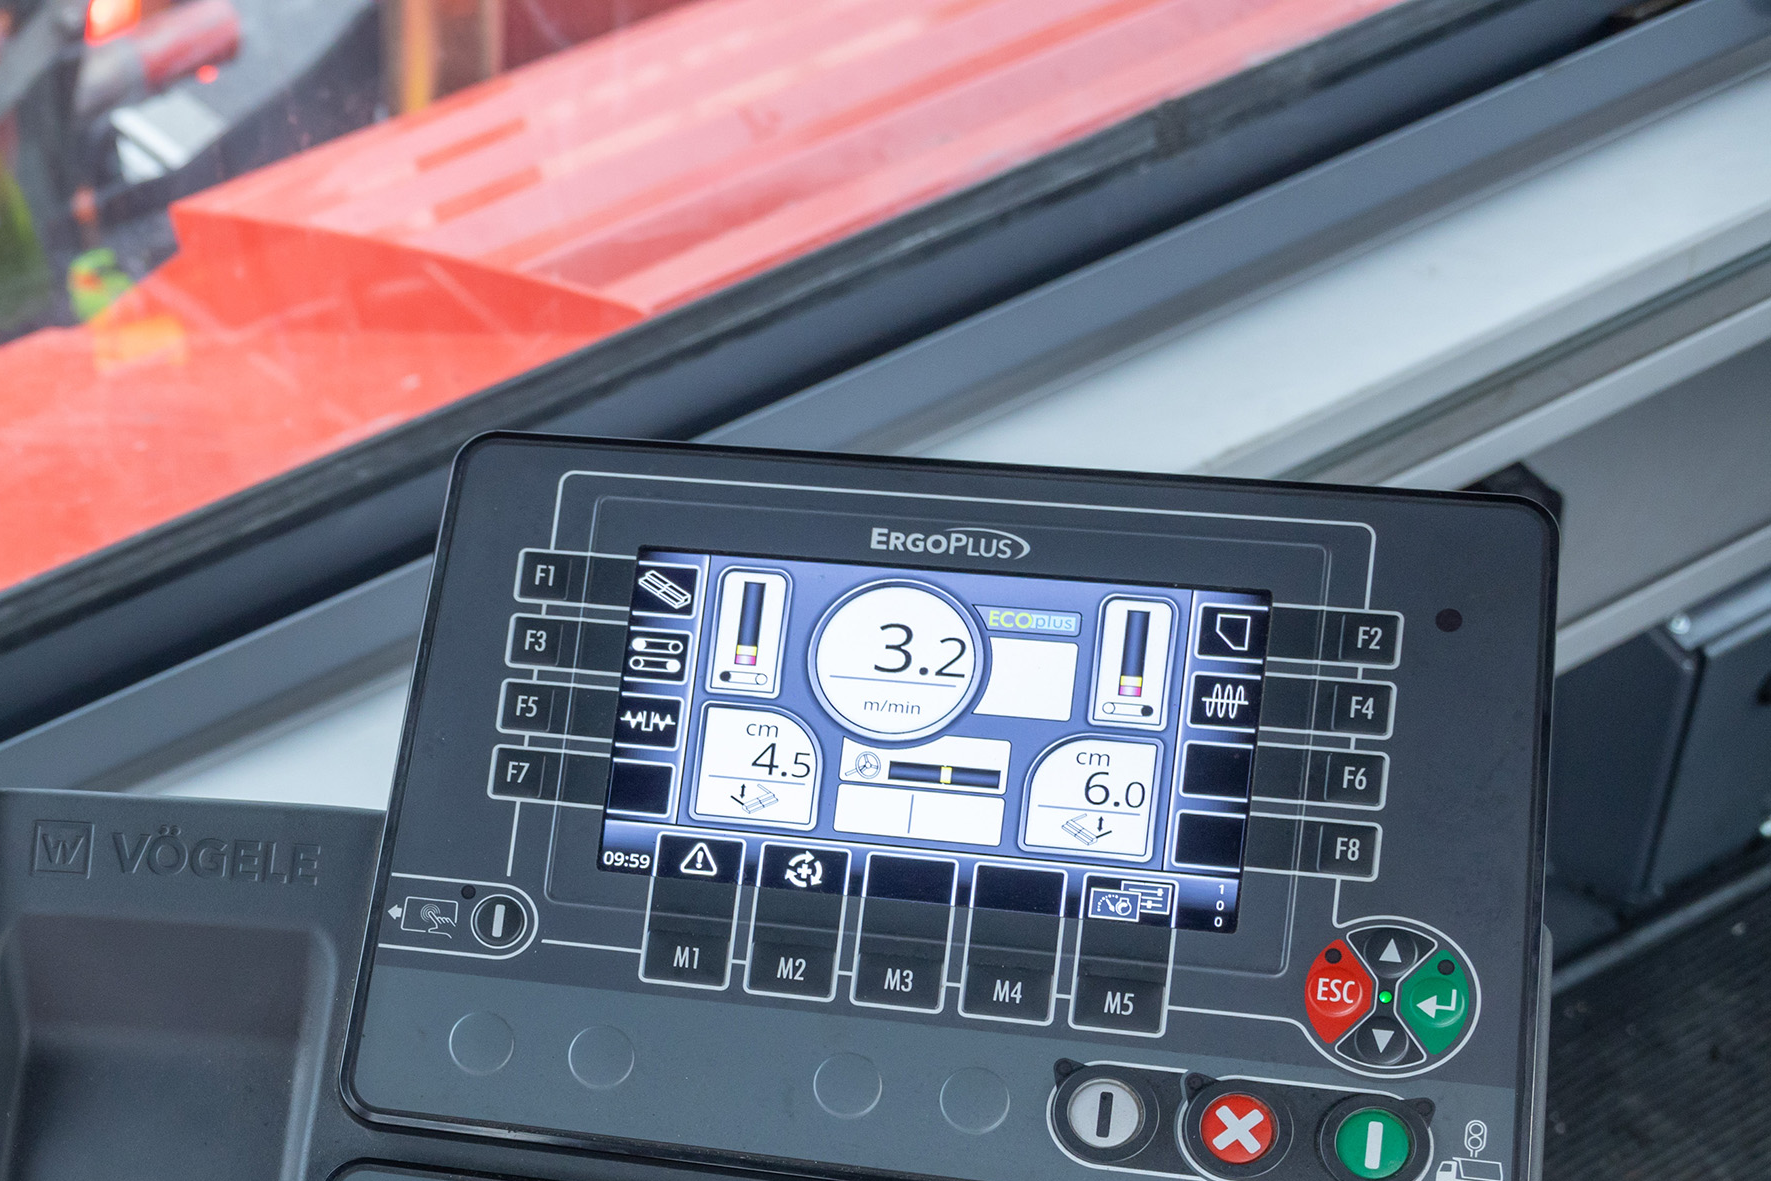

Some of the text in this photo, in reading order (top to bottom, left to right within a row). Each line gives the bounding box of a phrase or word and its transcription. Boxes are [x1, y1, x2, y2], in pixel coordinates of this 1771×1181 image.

[534, 564, 556, 587] F1
[988, 609, 1073, 630] ECOplus
[524, 629, 547, 652] F3
[1356, 626, 1383, 650] F2
[873, 622, 967, 679] 3.2
[515, 695, 538, 717] F5
[863, 698, 921, 715] m/min
[1349, 696, 1375, 720] F4
[745, 722, 779, 739] cm
[751, 742, 811, 778] 4.5
[1076, 751, 1110, 767] cm
[506, 761, 530, 784] F7
[1342, 766, 1367, 790] F6
[1084, 771, 1146, 808] 6.0
[112, 824, 321, 886] VÖGELE
[603, 851, 650, 870] 09:59
[1335, 837, 1361, 861] F8
[1218, 884, 1225, 895] 1
[673, 946, 700, 970] M1
[776, 957, 807, 982] M2
[883, 968, 914, 993] M3
[992, 980, 1024, 1005] M4
[1316, 977, 1356, 1004] ESC
[1103, 991, 1135, 1017] M5
